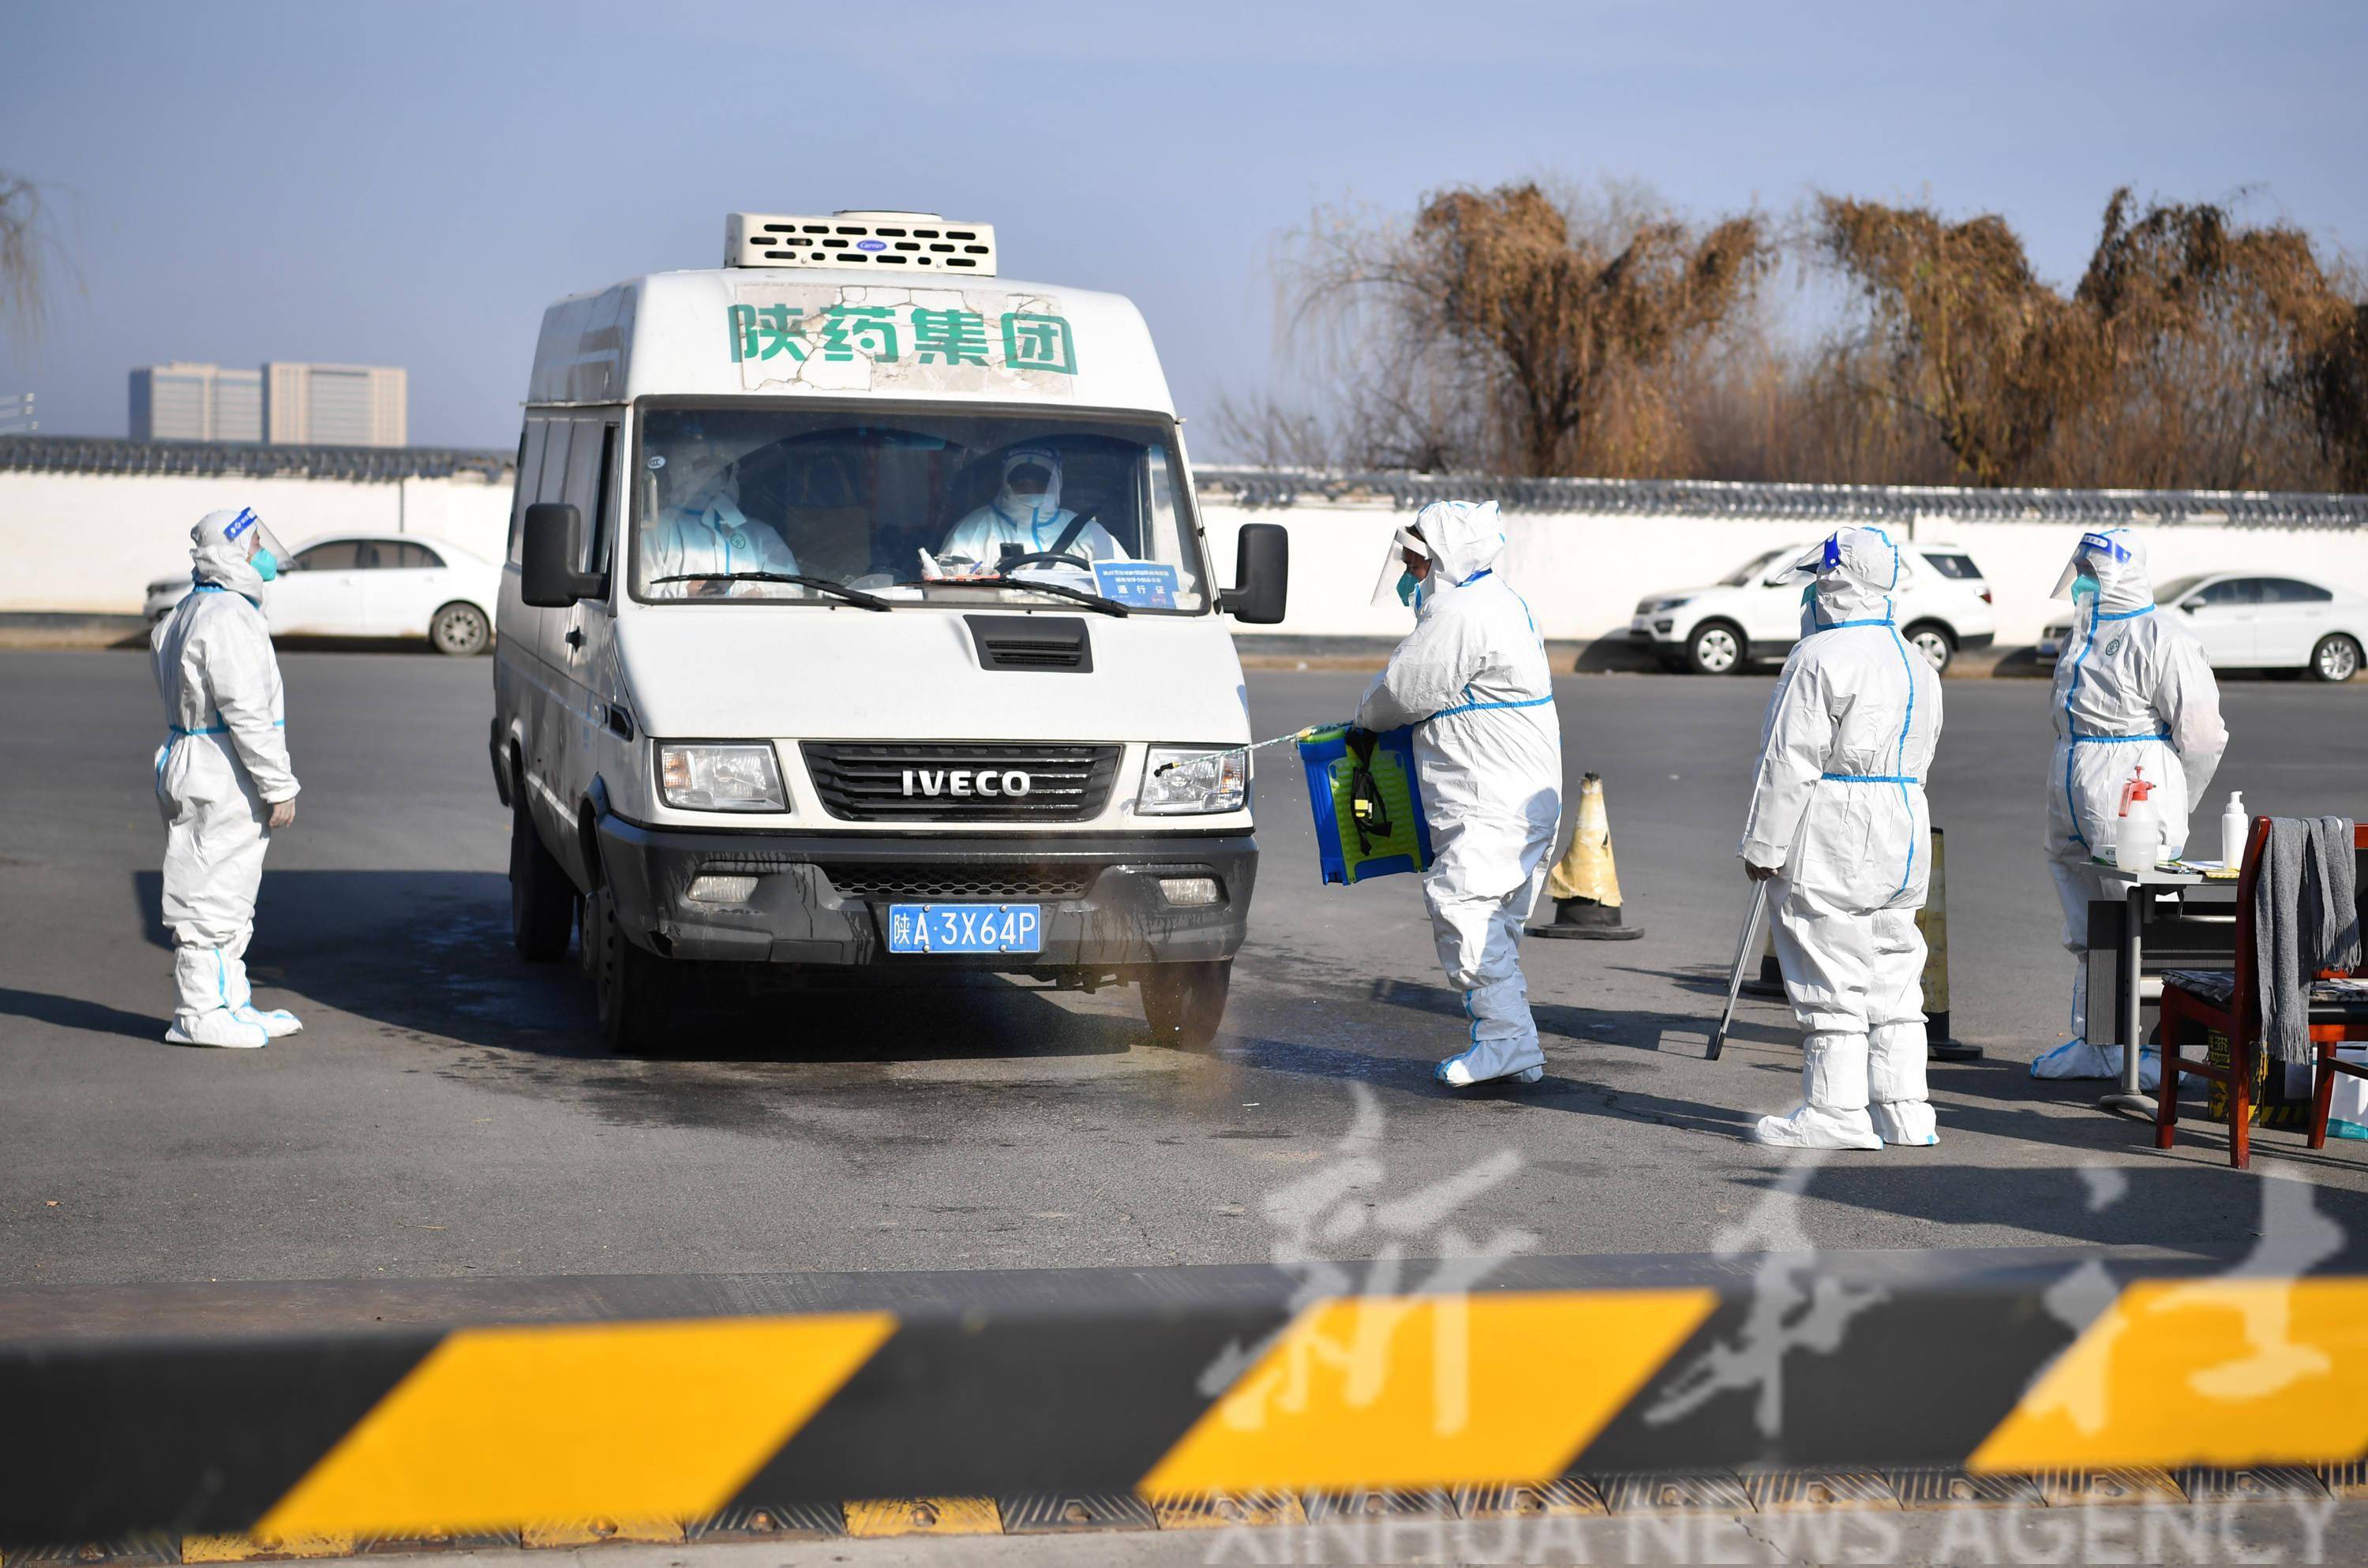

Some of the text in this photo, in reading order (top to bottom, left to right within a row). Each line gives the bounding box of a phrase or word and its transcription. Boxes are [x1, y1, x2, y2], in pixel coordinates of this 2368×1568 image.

[728, 303, 1078, 376] 陕药集团
[903, 770, 1031, 796] IVECO
